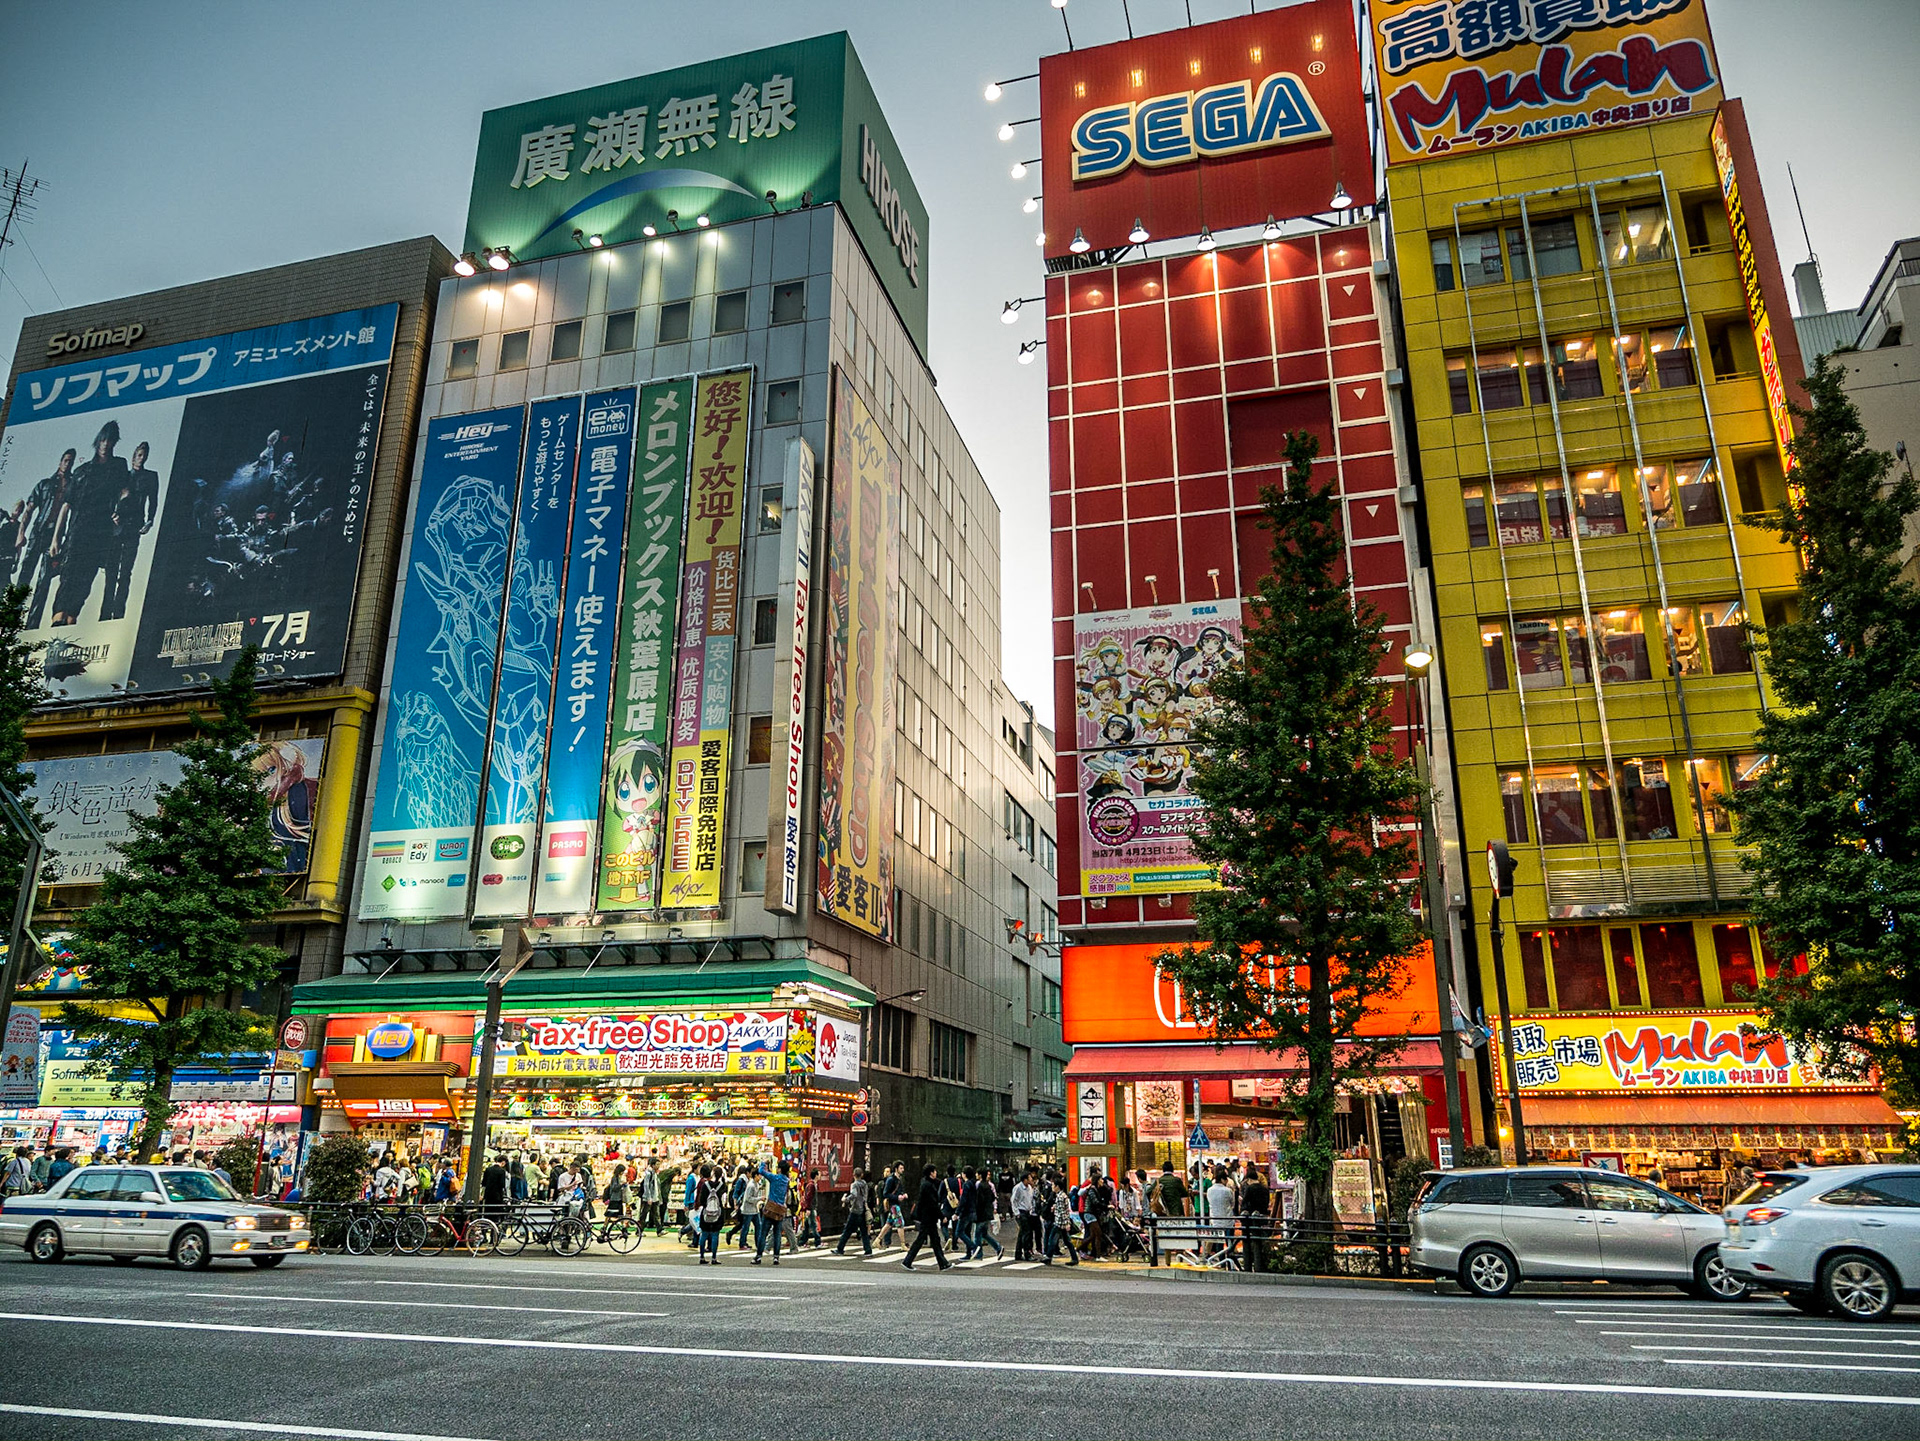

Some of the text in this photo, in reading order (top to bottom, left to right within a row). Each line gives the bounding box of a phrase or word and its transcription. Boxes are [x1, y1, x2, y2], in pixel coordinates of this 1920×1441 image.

[1386, 33, 1718, 151] Mulan
[510, 75, 797, 188] 廣瀬無線
[1072, 70, 1332, 182] SEGA
[1428, 97, 1691, 154] ムーラン AKIBA 中央通り店
[860, 124, 920, 288] HIROSE
[46, 322, 145, 358] Sofmap
[30, 325, 376, 411] ソフマップ アミューズメント館
[455, 424, 494, 441] Hey
[590, 422, 625, 435] money
[547, 413, 571, 509] ゲームセンターを
[801, 449, 811, 549] AKKY
[1191, 606, 1218, 616] SEGA
[262, 610, 310, 648] 7月
[791, 578, 809, 715] Tax-free
[787, 721, 803, 809] Shop
[849, 706, 876, 868] Shop
[670, 759, 696, 872] DUTY FREE
[694, 739, 722, 872] 愛客国際免税店
[410, 851, 428, 861] Edy
[440, 841, 465, 850] WAON
[551, 839, 584, 851] PASMO
[605, 852, 655, 867] このビル
[606, 870, 651, 885] 地下1F
[371, 1030, 411, 1048] Hey
[529, 1018, 725, 1046] Tax-free Shop
[733, 1026, 773, 1037] AKKY
[1555, 1037, 1600, 1065] 市場
[1603, 1019, 1791, 1077] Mulan
[514, 1057, 612, 1071] 海外向け電気製品
[1515, 1058, 1557, 1086] 販売
[1622, 1068, 1680, 1086] ムーラン
[1682, 1070, 1727, 1085] AKIBA
[379, 1099, 414, 1112] Hey
[541, 1101, 604, 1112] Tax-free Shop
